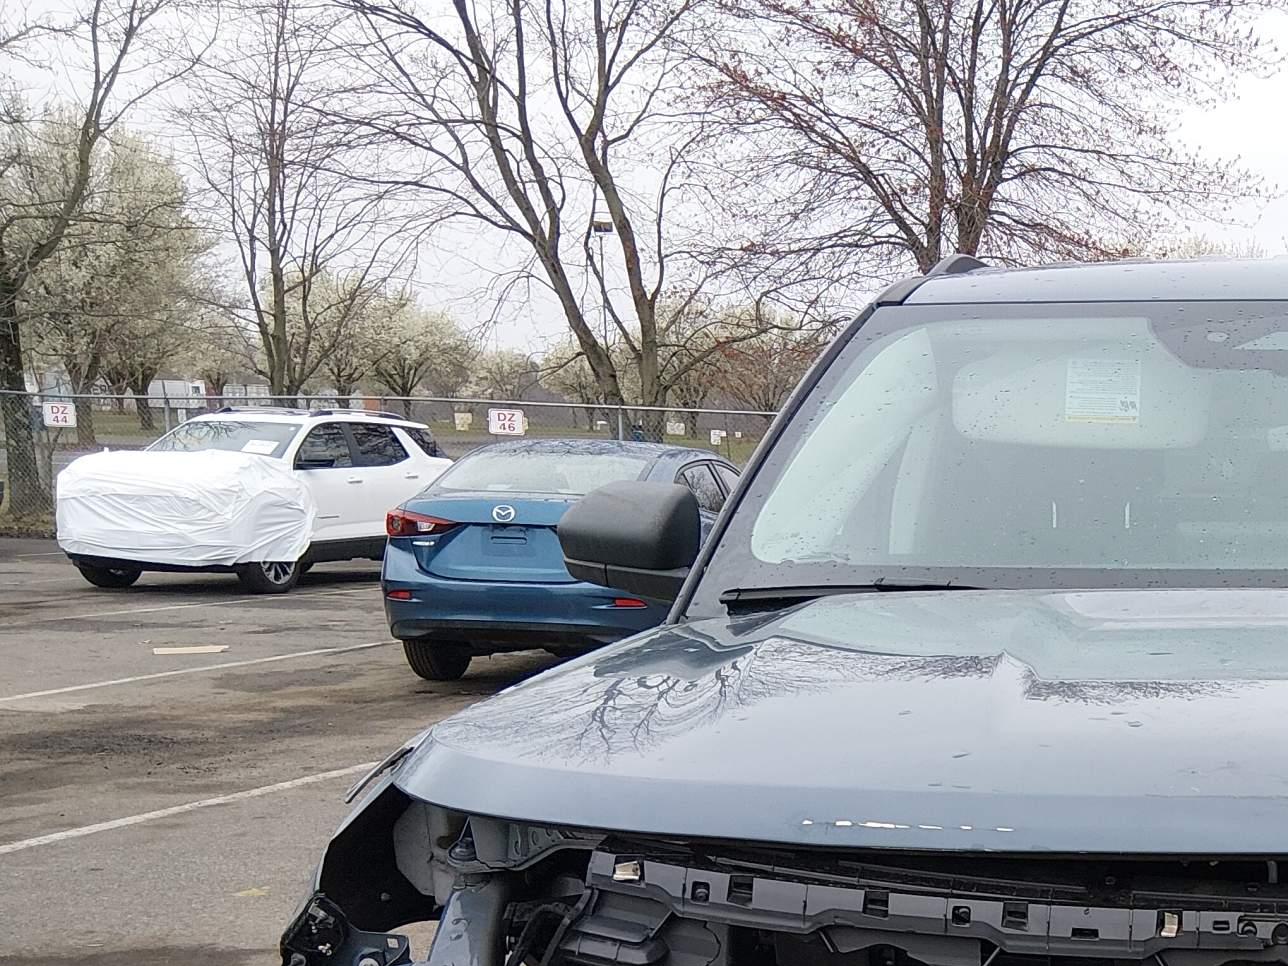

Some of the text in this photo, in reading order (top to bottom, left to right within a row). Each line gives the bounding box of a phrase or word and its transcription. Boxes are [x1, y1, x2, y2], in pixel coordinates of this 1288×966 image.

[51, 405, 69, 415] DZ
[52, 415, 68, 423] 44
[497, 412, 516, 422] DZ
[499, 422, 516, 432] 46
